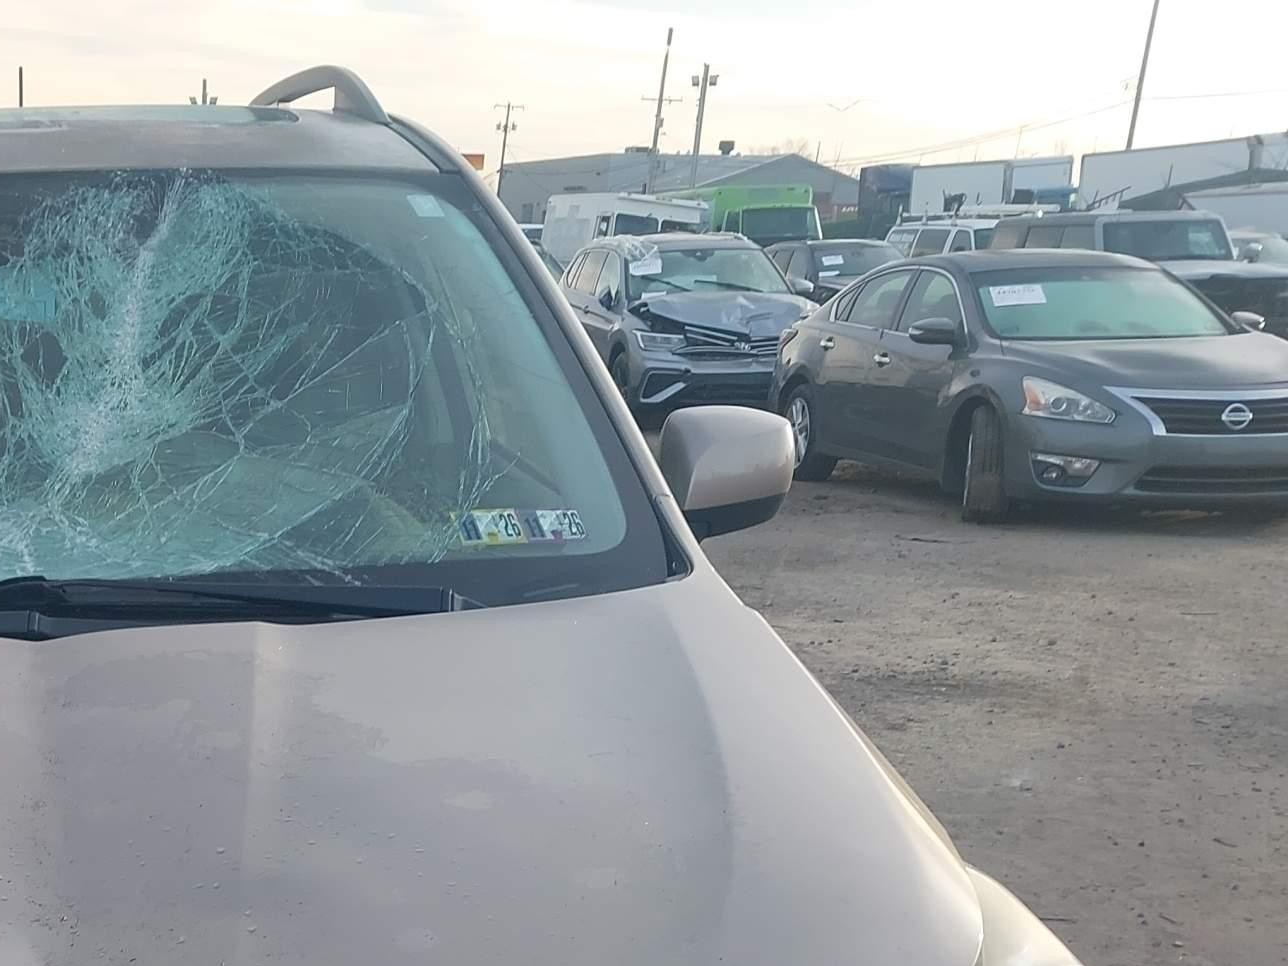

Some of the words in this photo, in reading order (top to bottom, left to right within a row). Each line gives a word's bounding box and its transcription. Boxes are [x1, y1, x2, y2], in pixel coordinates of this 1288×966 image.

[462, 519, 482, 541] 11
[499, 513, 522, 537] 26
[524, 516, 546, 539] 11
[563, 512, 585, 537] 26
